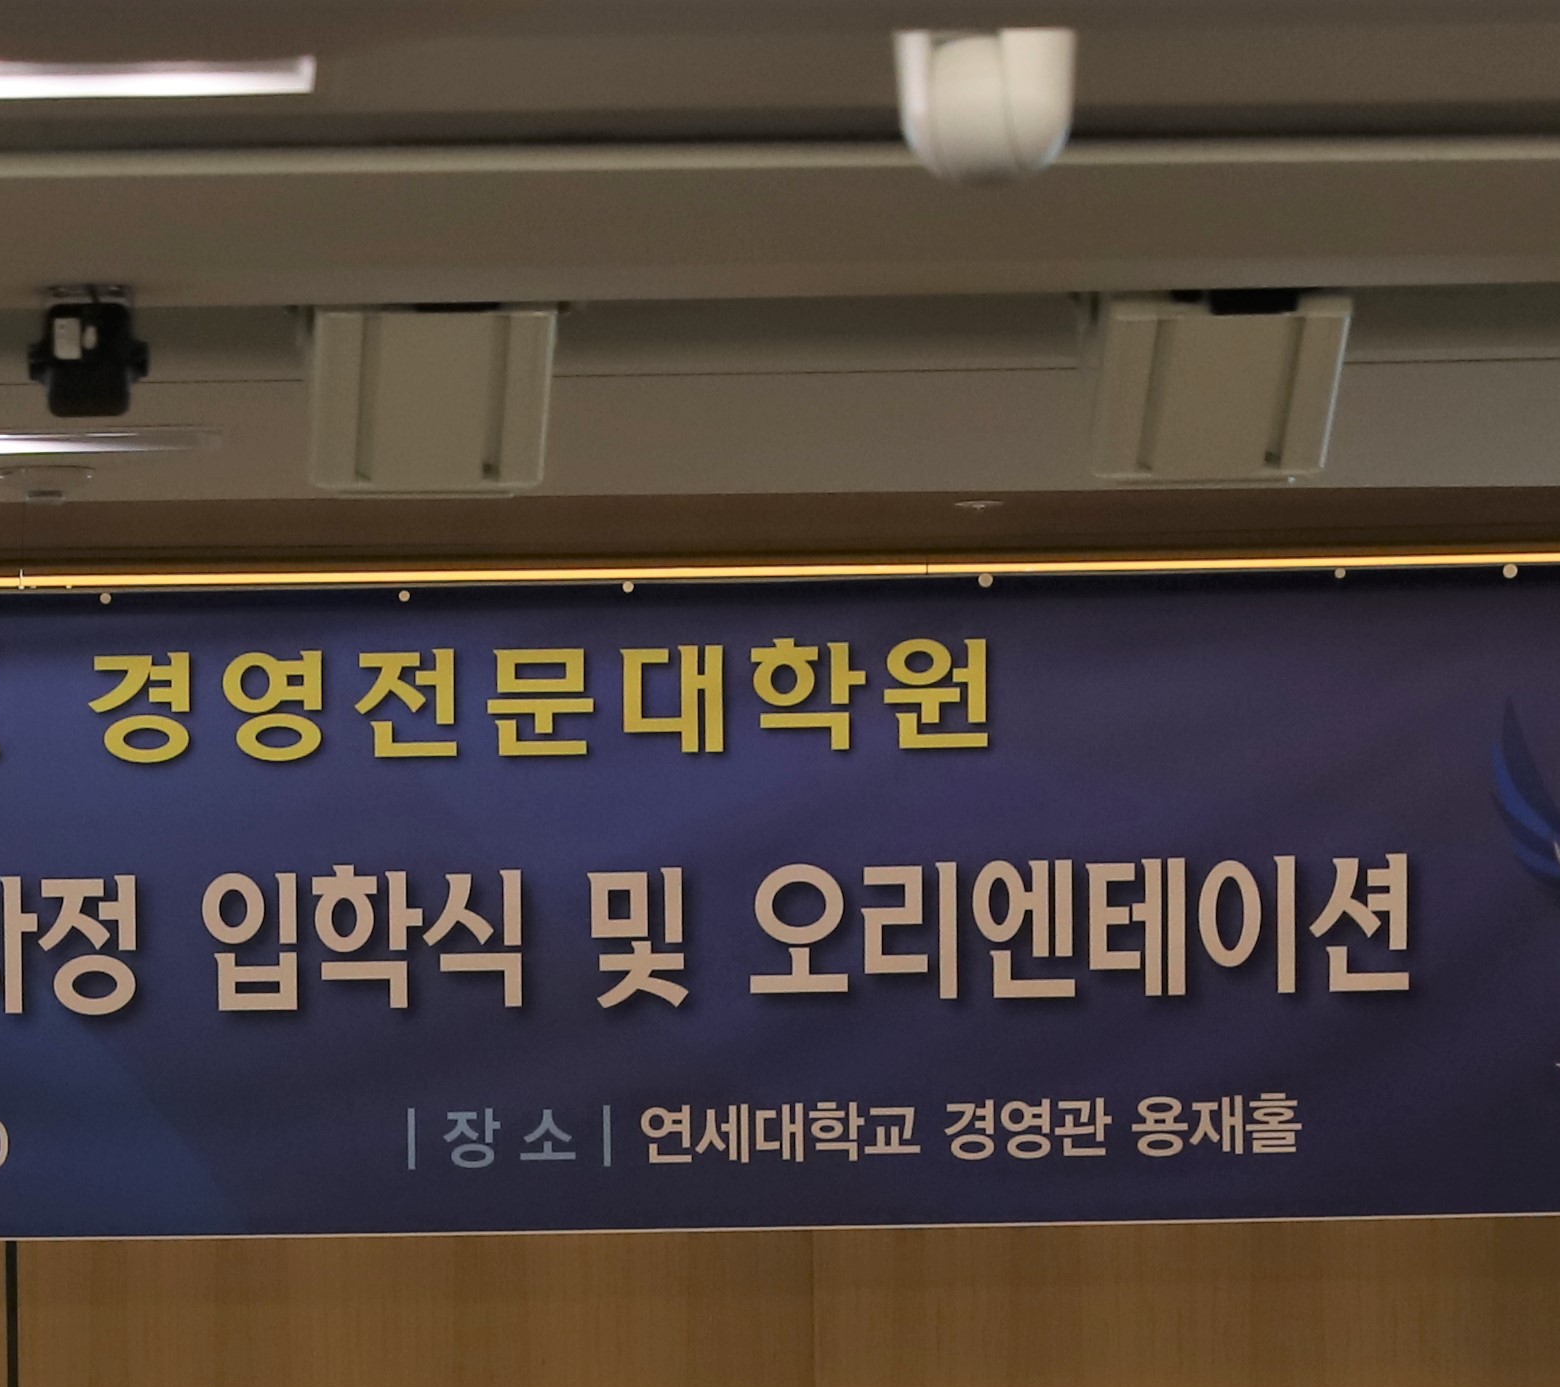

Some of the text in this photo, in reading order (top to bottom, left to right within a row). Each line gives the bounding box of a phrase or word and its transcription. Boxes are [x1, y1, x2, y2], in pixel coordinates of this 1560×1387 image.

[89, 639, 988, 762] 경영전문대학원
[202, 865, 521, 1010] 입학식
[587, 867, 688, 1008] 및
[750, 854, 1409, 998] 오리엔테이션
[641, 1102, 920, 1163] 연세대학교
[945, 1098, 1111, 1159] 경영관
[1132, 1093, 1302, 1156] 용재홀
